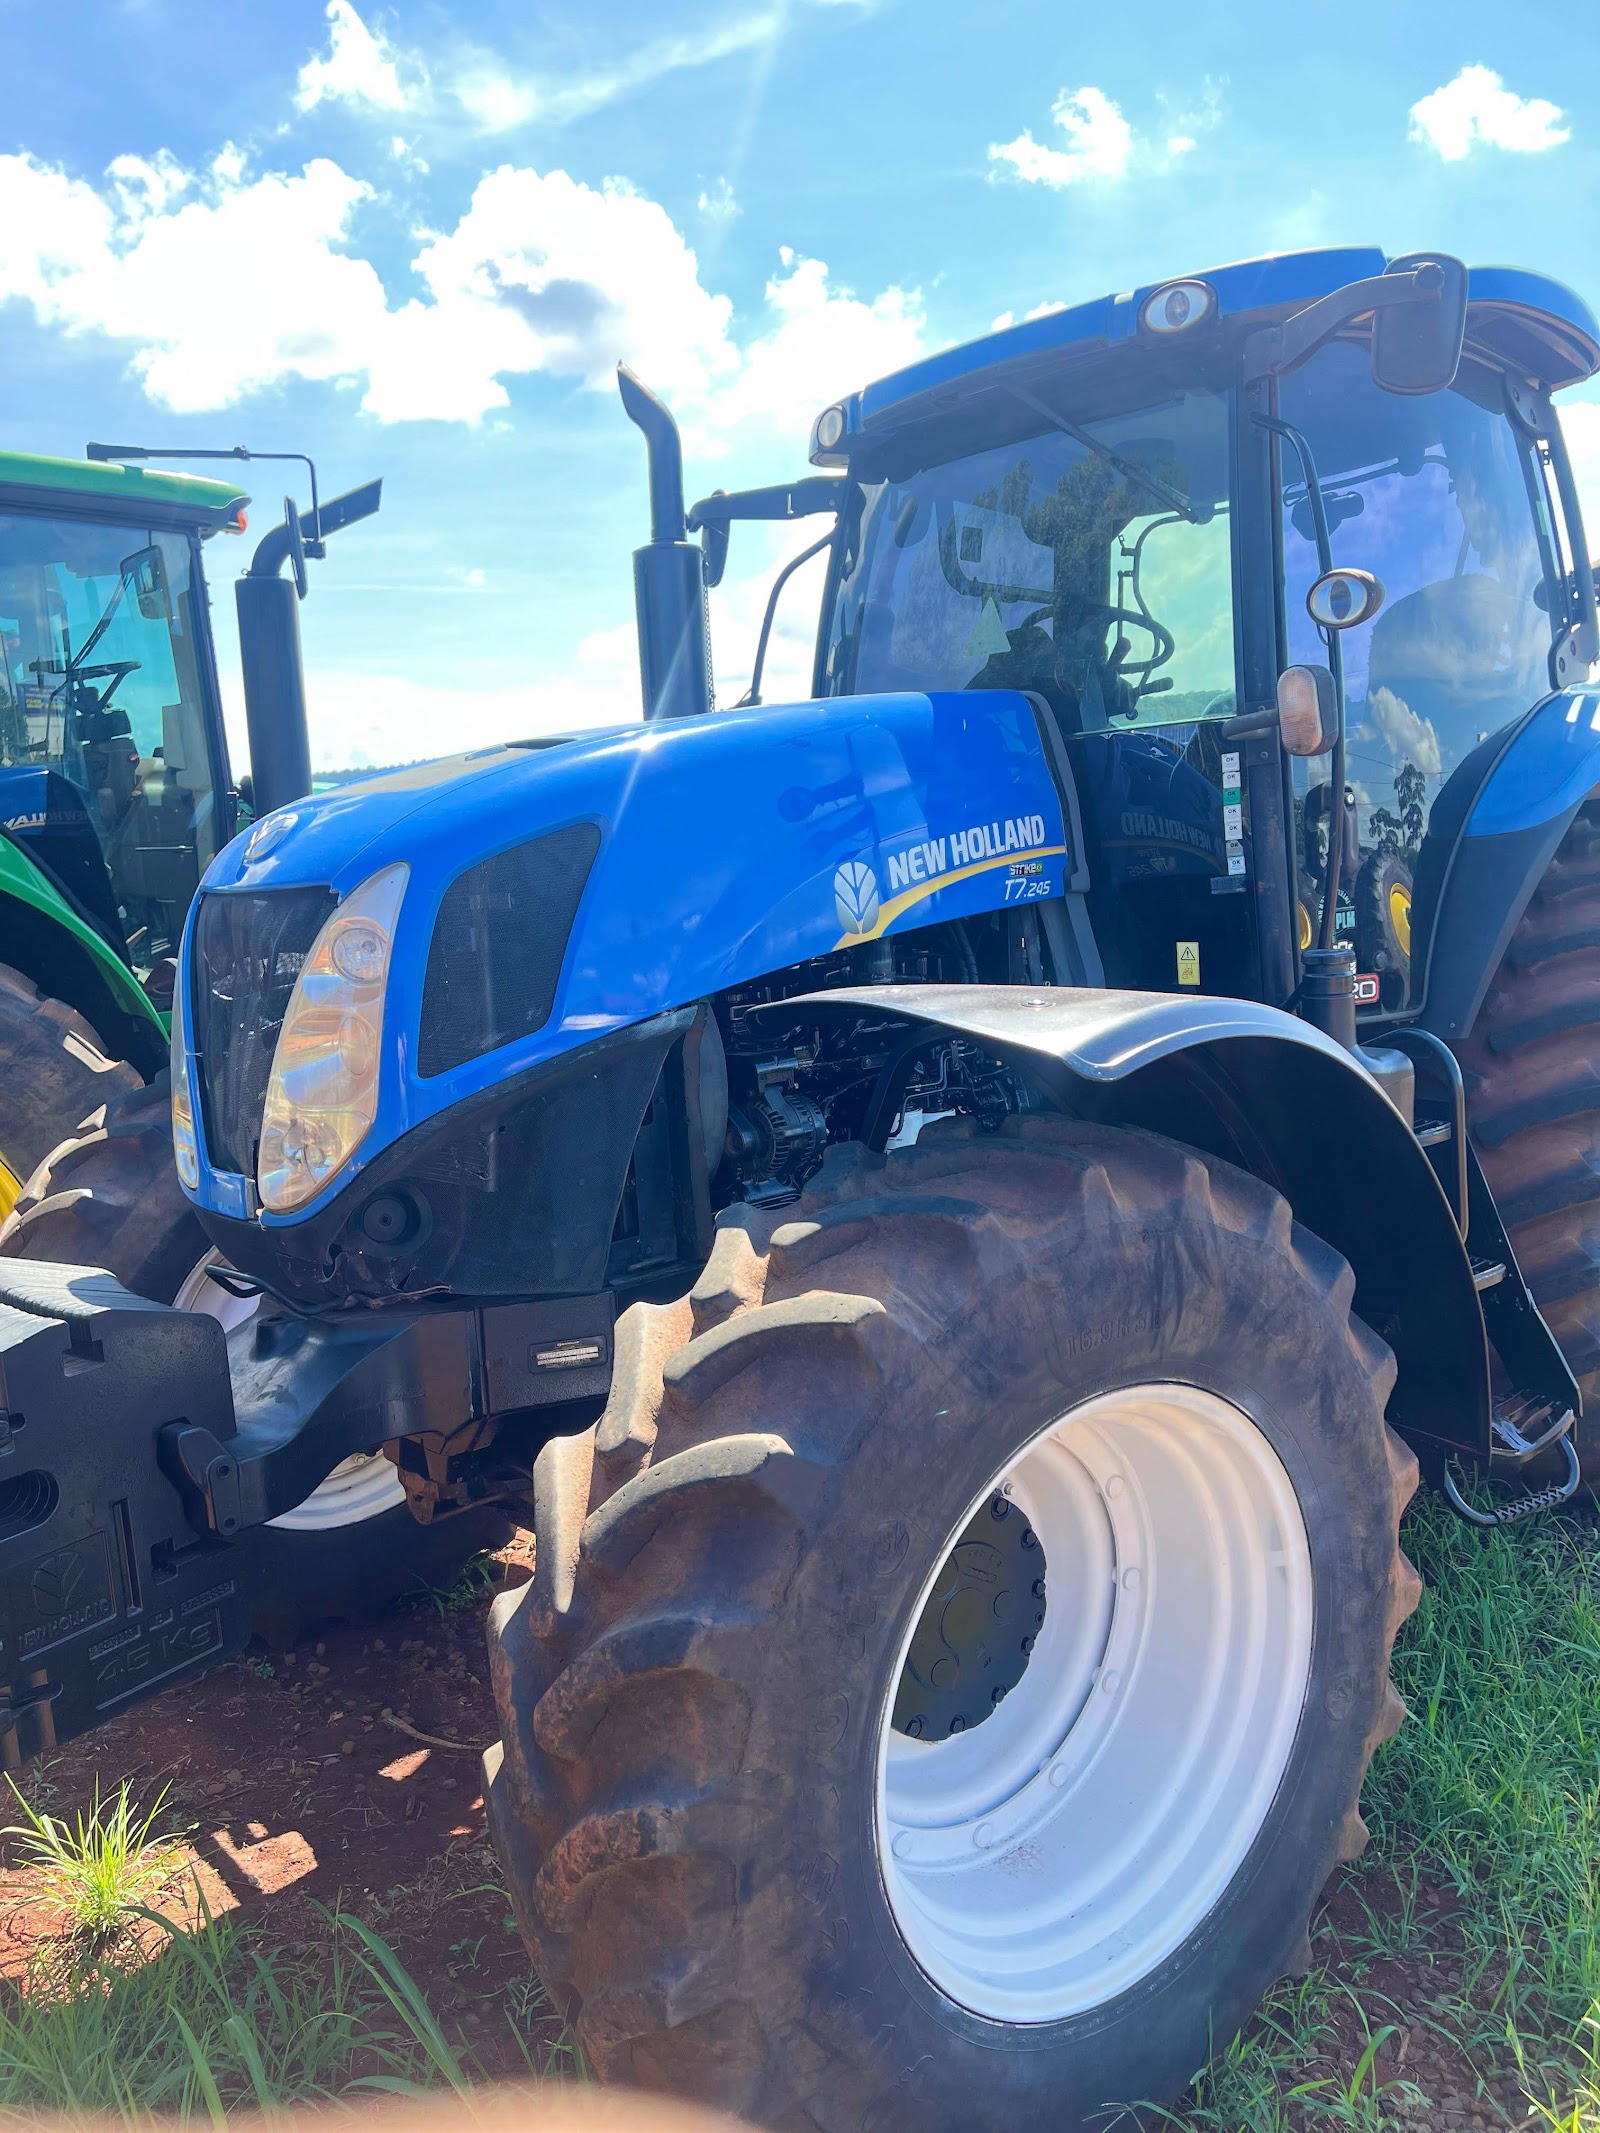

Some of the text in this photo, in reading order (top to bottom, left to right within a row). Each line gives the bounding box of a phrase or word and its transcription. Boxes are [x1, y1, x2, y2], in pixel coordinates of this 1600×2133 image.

[888, 814, 1045, 890] NEW HOLLAND
[1004, 877, 1052, 901] T7.245
